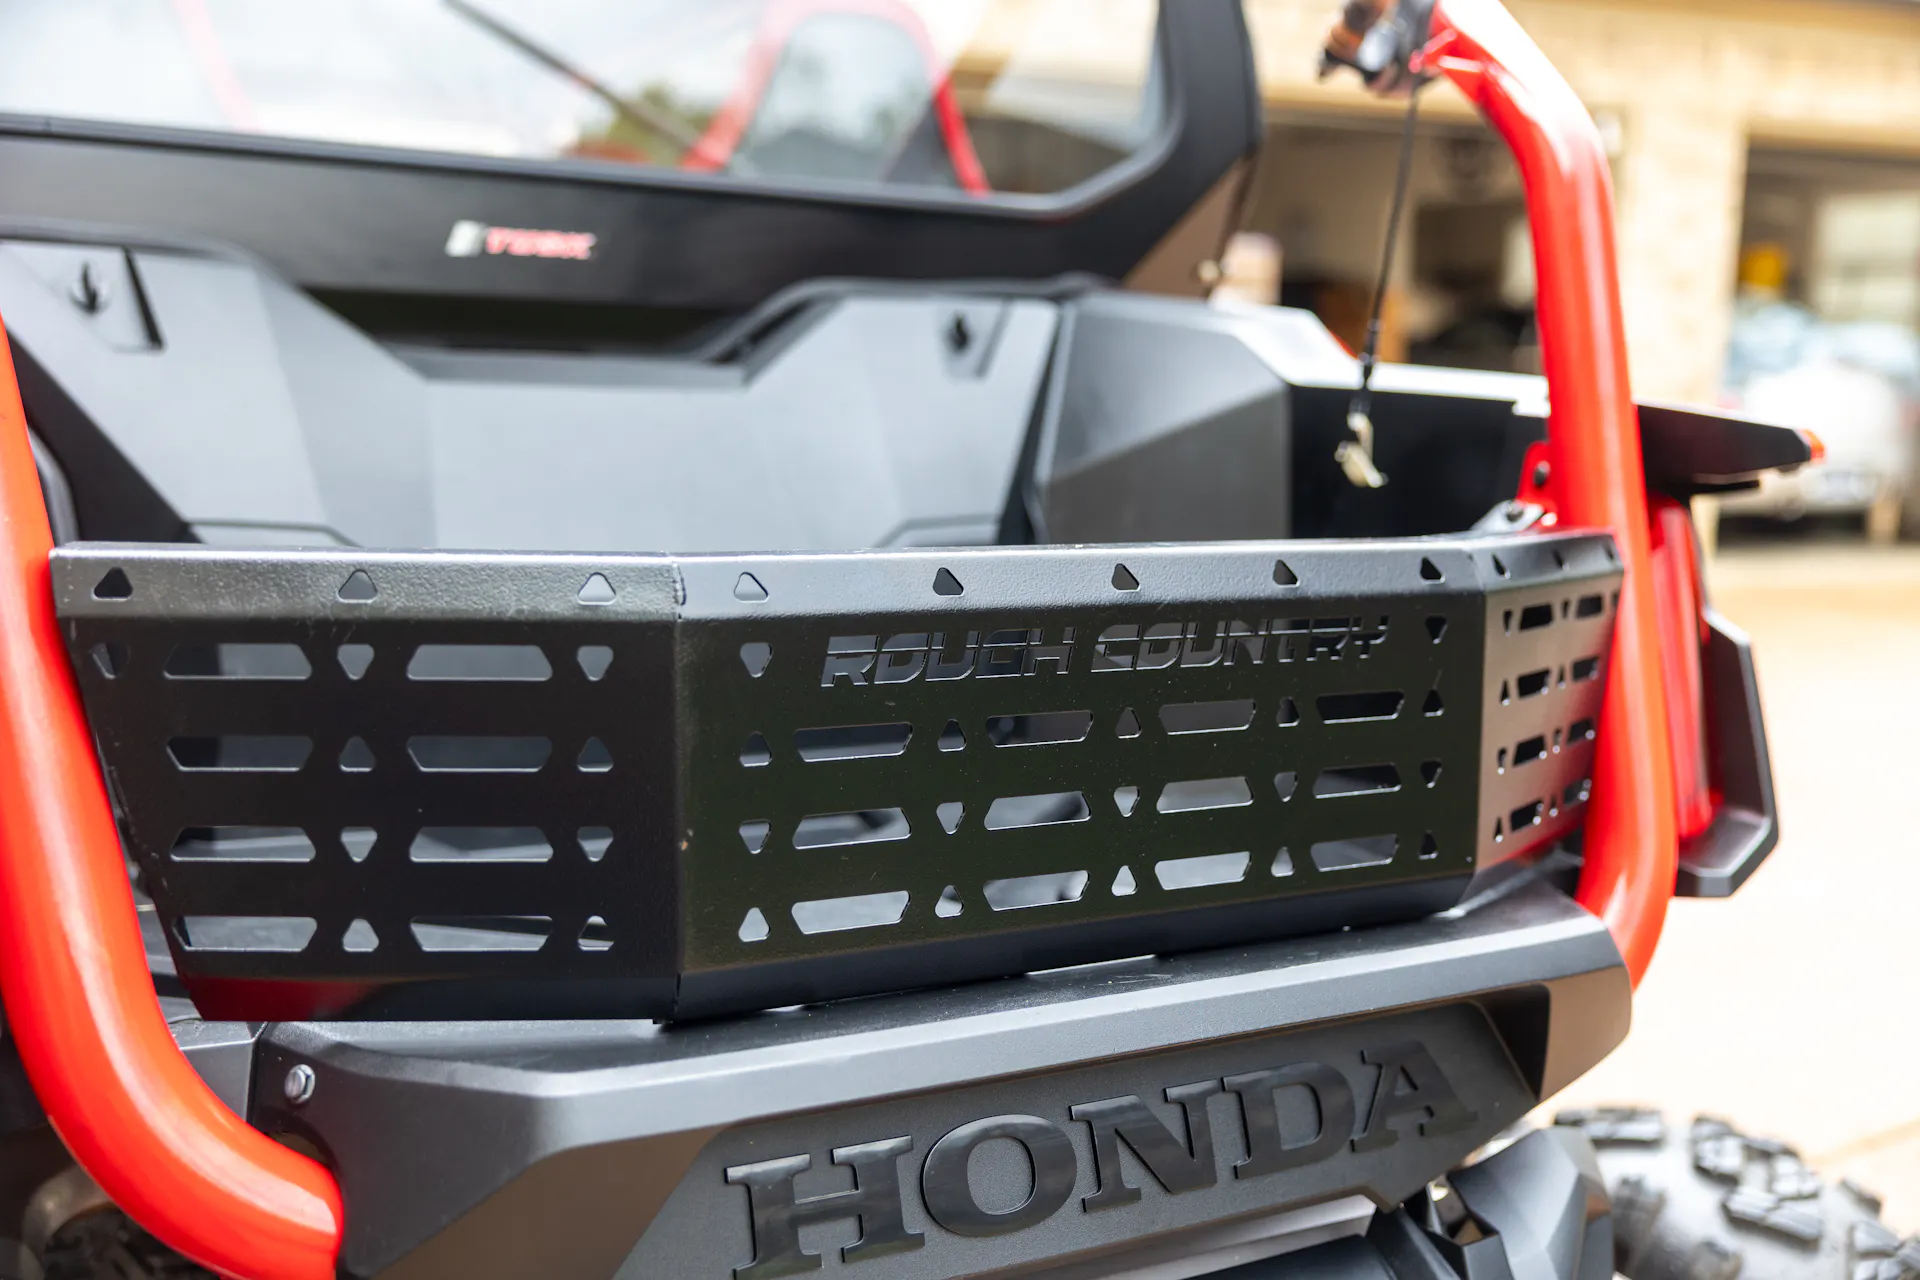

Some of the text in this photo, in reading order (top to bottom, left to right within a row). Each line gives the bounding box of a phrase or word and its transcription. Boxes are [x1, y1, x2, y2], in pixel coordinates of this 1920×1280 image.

[821, 615, 1389, 687] ROUGH COUNTRY
[724, 1040, 1478, 1280] HONDA
